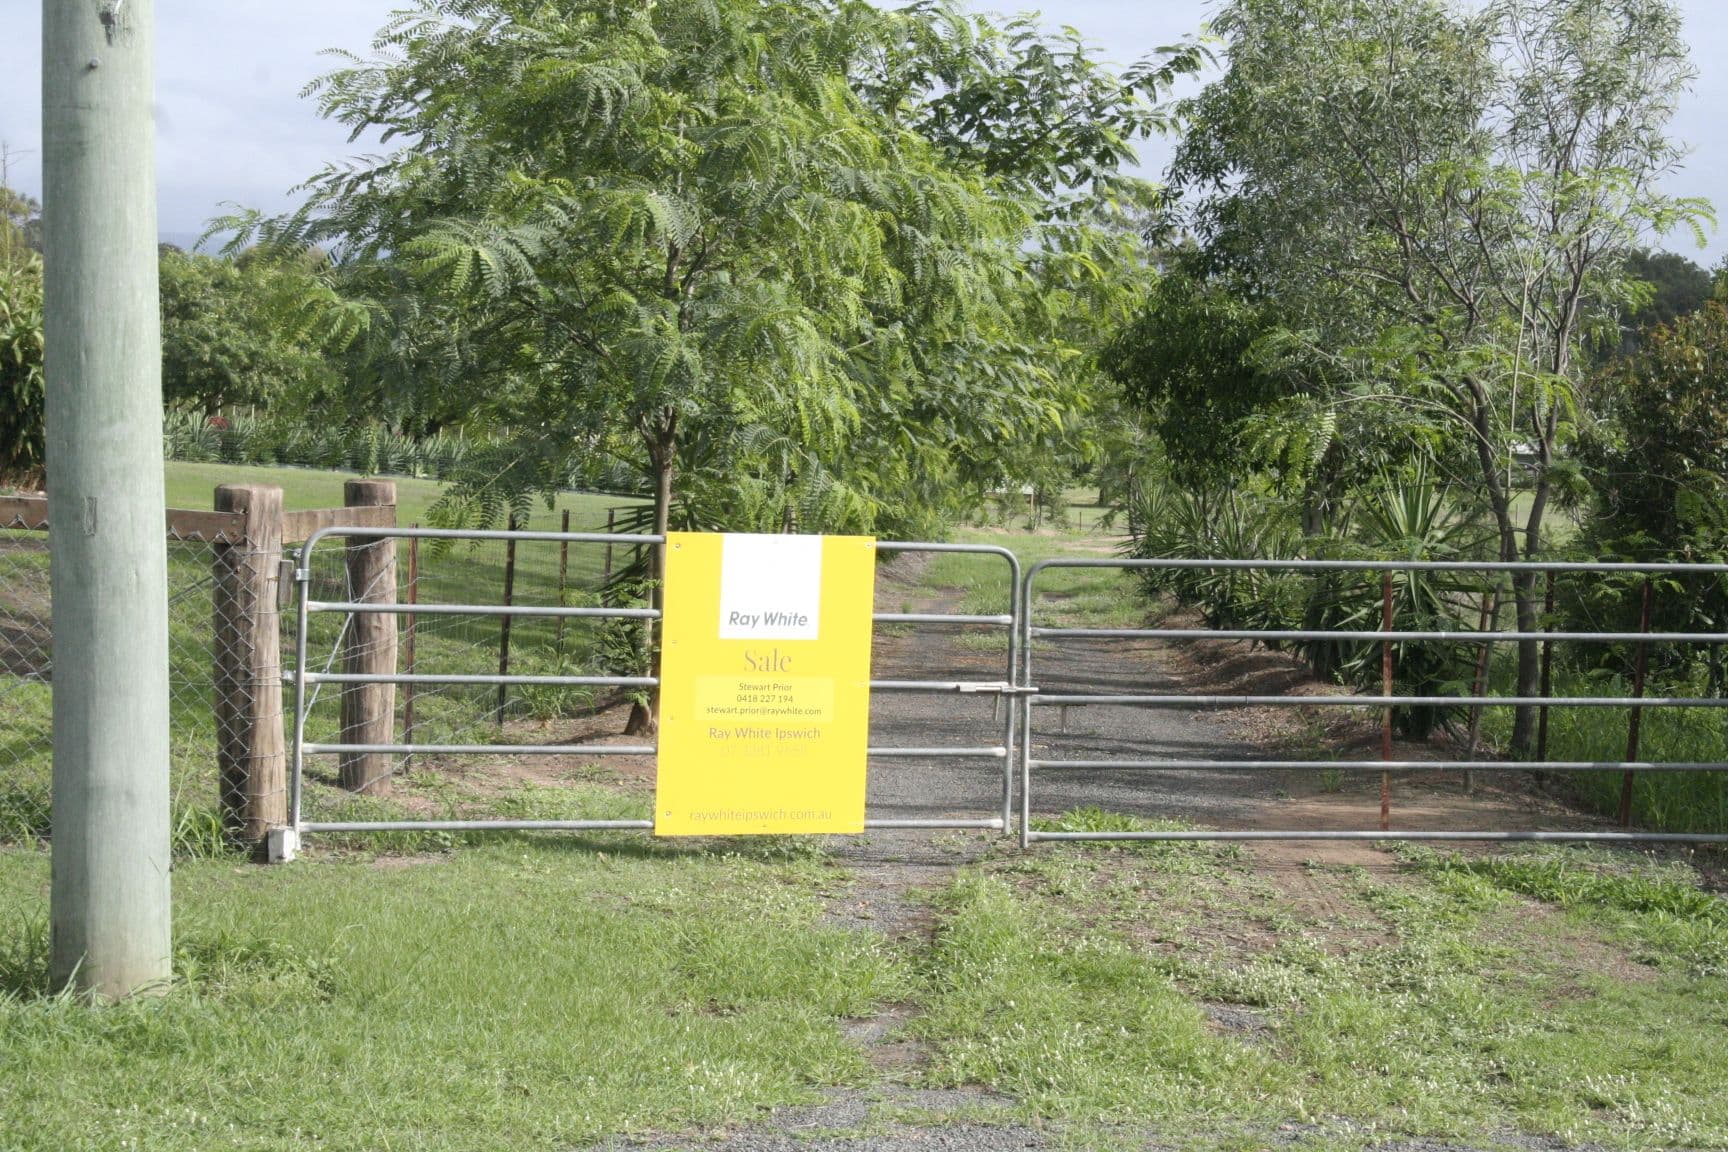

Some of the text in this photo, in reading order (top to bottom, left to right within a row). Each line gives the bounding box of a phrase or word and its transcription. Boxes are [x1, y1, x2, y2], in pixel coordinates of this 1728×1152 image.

[728, 611, 808, 629] Ray White
[744, 648, 792, 673] Sale
[739, 682, 793, 692] Stewart Prior
[736, 694, 794, 704] 0418 227 194
[706, 705, 822, 716] stewart.prior@raywhite.com
[709, 727, 821, 741] Ray White Ipswich
[689, 808, 832, 822] raywhiteipswich.com.au
